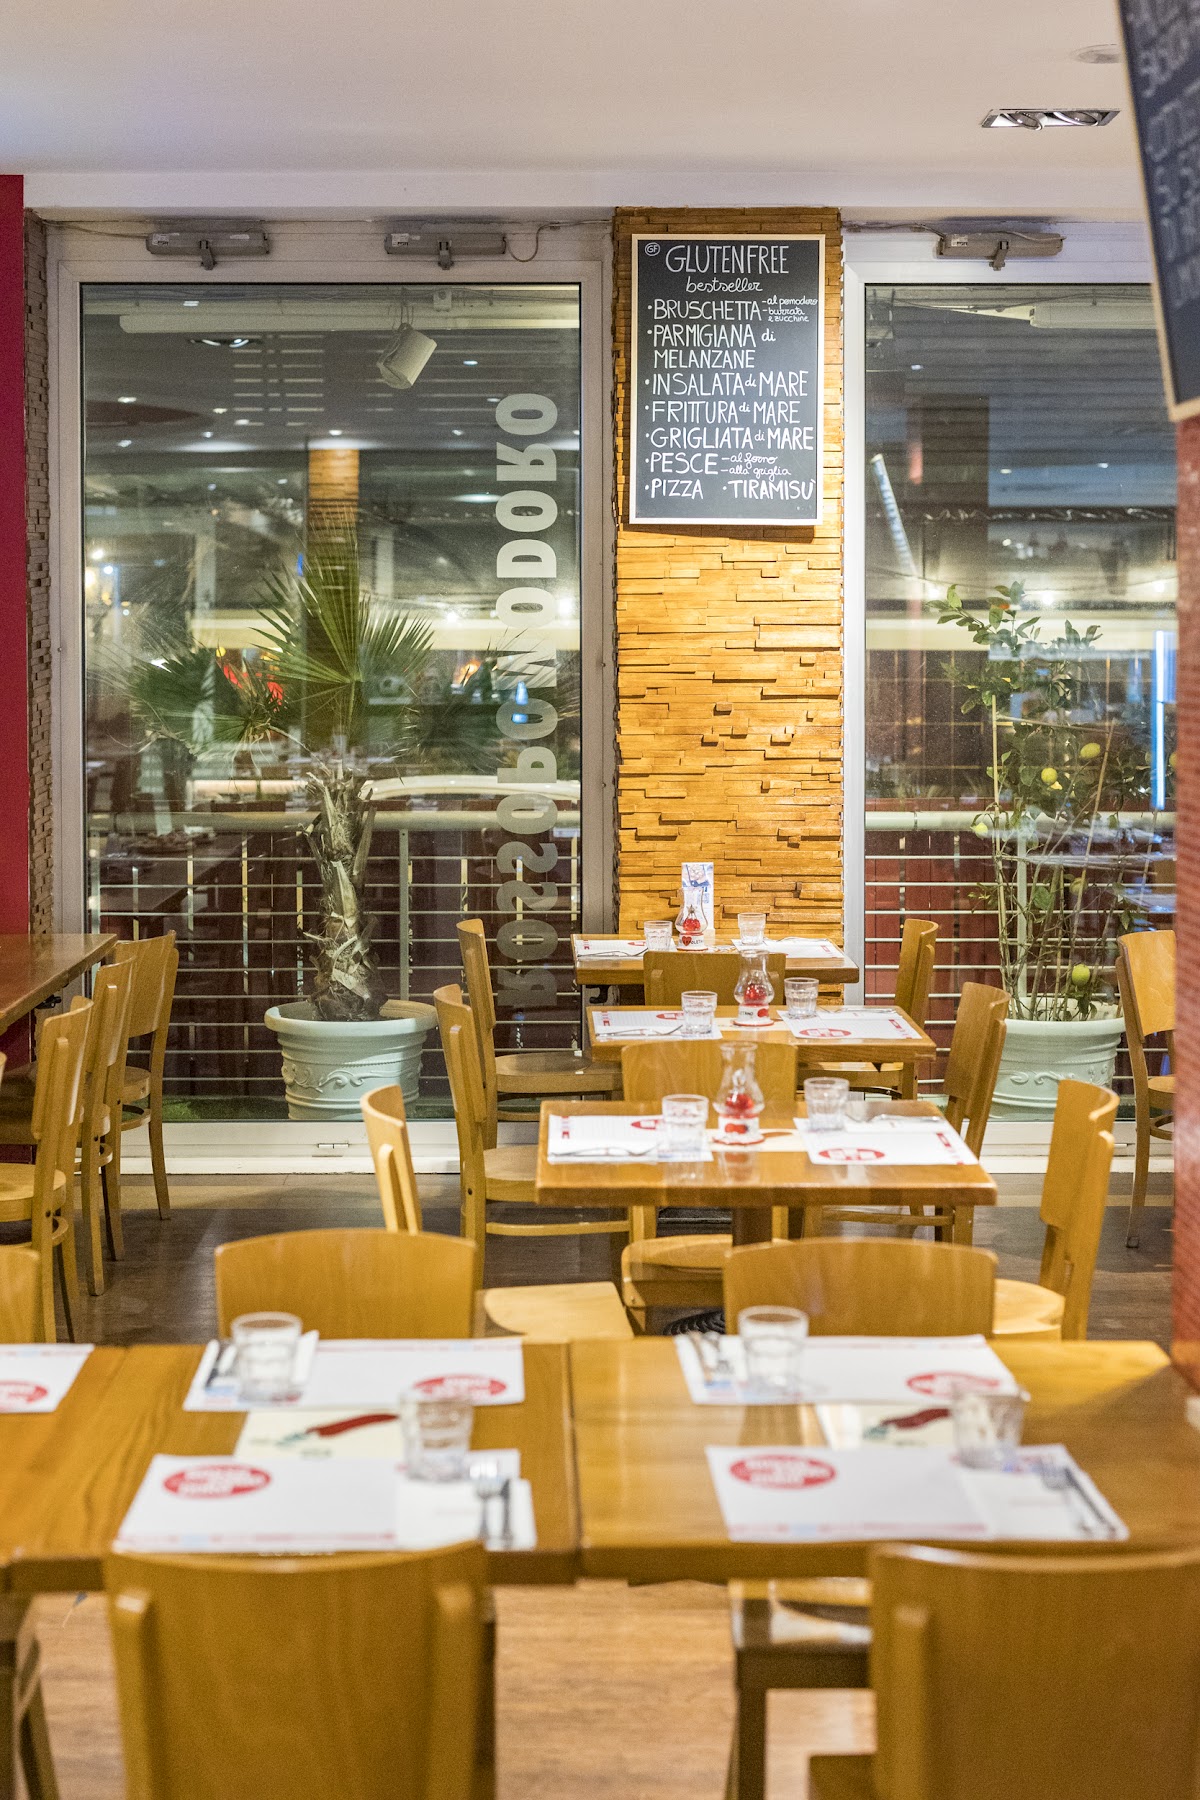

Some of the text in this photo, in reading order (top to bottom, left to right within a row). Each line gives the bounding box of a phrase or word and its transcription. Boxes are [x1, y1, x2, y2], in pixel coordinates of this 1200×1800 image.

[665, 245, 789, 274] GLUTENFREE
[685, 275, 763, 293] bestseller
[653, 299, 762, 320] BRUSCHETTA
[653, 324, 777, 348] PARMIGIANA di
[653, 349, 756, 369] MELANZANE
[652, 370, 809, 397] INSALATA di MARE
[652, 400, 801, 426] FRITTURA di MARE
[650, 426, 815, 450] GRIGLIATA di MARE
[650, 452, 719, 475] PESCE
[744, 452, 778, 470] forno
[752, 465, 792, 482] griglia
[651, 478, 704, 500] PIZZA
